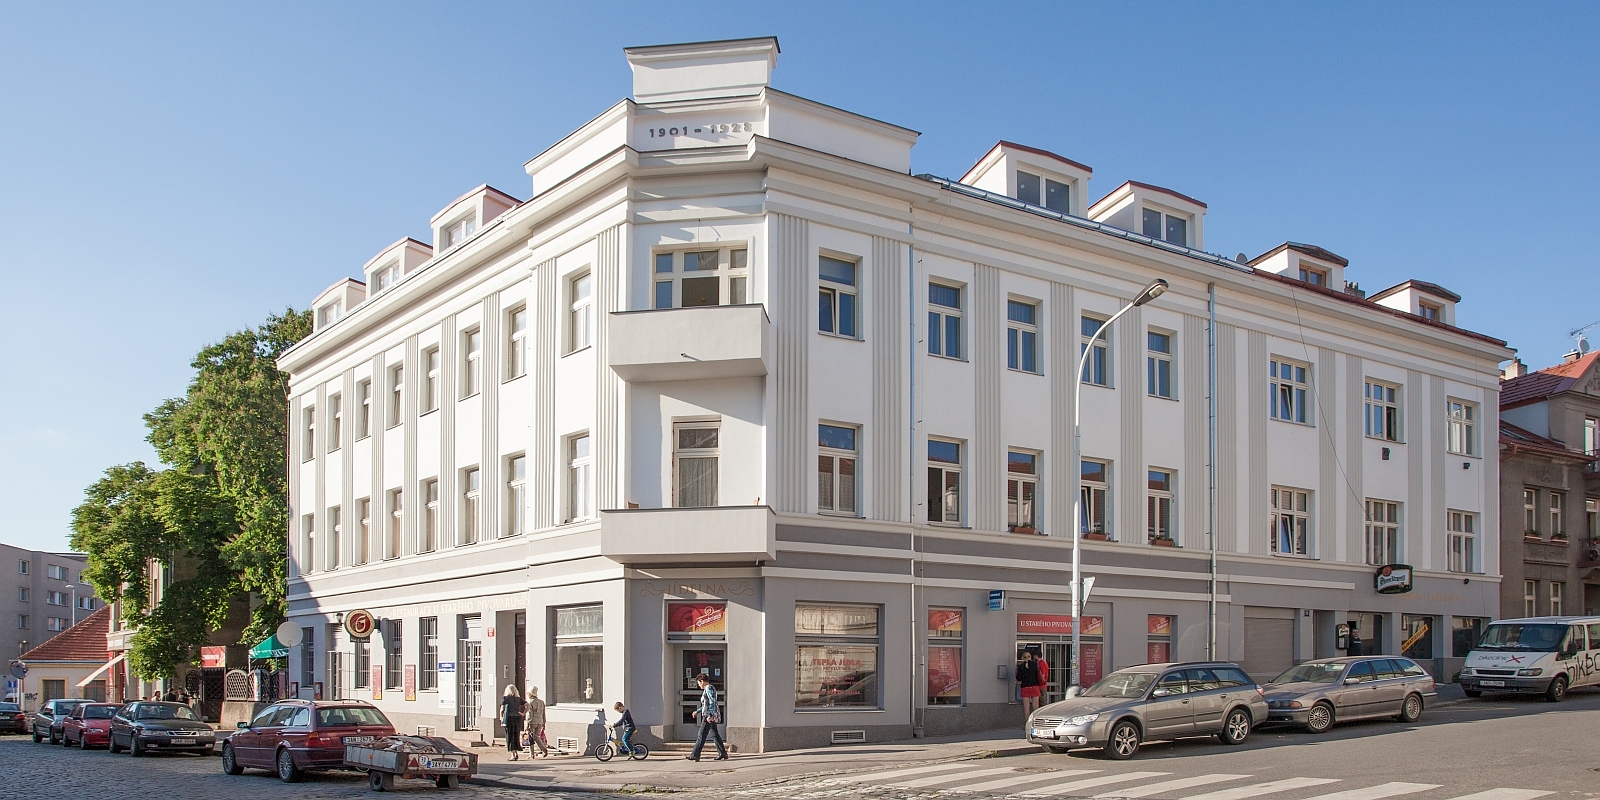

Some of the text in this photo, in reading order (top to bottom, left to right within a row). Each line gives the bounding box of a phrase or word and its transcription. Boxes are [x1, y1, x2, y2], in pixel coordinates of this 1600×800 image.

[649, 126, 688, 138] 1901
[709, 121, 753, 134] 1928
[667, 581, 726, 596] JÍDELNA
[392, 597, 517, 617] RESTAURACE U STARÉHO PIVOVARU
[1025, 619, 1052, 628] STARÉHO
[1051, 620, 1073, 628] PIVOVA
[812, 657, 837, 666] TEPLÁ
[838, 657, 861, 666] JÍDLA
